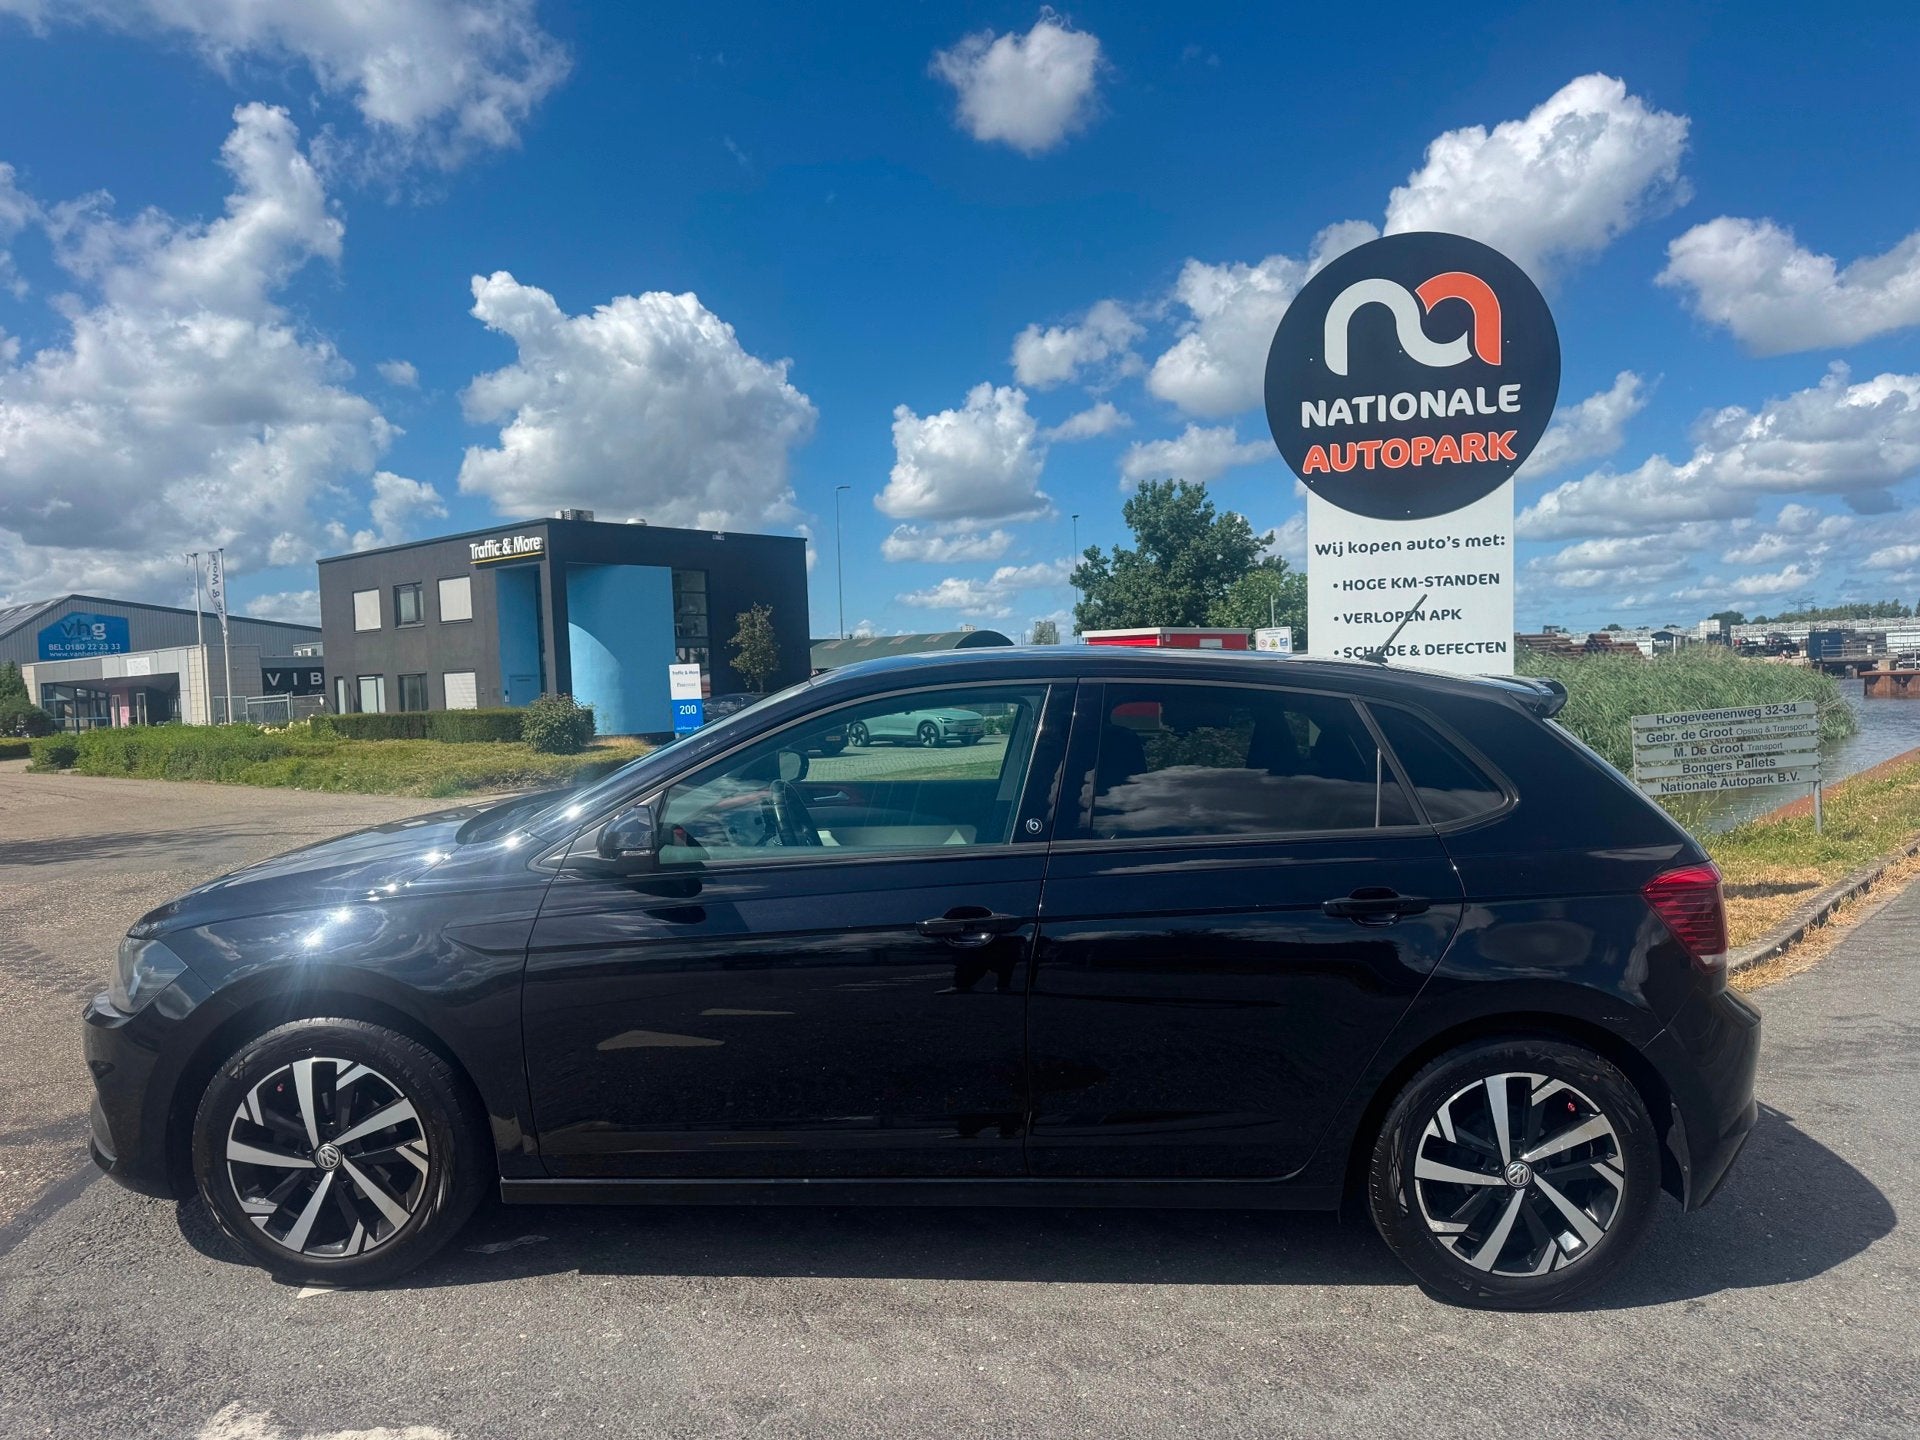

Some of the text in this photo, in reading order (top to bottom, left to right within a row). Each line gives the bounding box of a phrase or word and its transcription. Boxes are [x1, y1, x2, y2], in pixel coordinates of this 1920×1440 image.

[1301, 383, 1521, 428] NATIONALE
[1302, 430, 1518, 474] AUTOPARK
[469, 535, 544, 560] Traffic & More
[1315, 534, 1506, 557] Wij kopen auto's met:
[1343, 573, 1500, 591] HOGE KM-STANDEN
[1343, 608, 1463, 625] VERLOPEN APK
[60, 618, 107, 640] vhg
[65, 643, 85, 651] 0180
[1410, 644, 1424, 657] &
[1425, 641, 1507, 655] DEFECTEN
[679, 705, 697, 715] 200
[1656, 703, 1797, 725] Hoogeveenenweg 32-34
[1646, 723, 1808, 743] Gebr. de Groot Opslag & Transport
[1673, 742, 1783, 758] M. De Groot Transport
[1682, 758, 1776, 775] Bongers Pallets
[1661, 771, 1800, 793] Nationale Autopark B.V.
